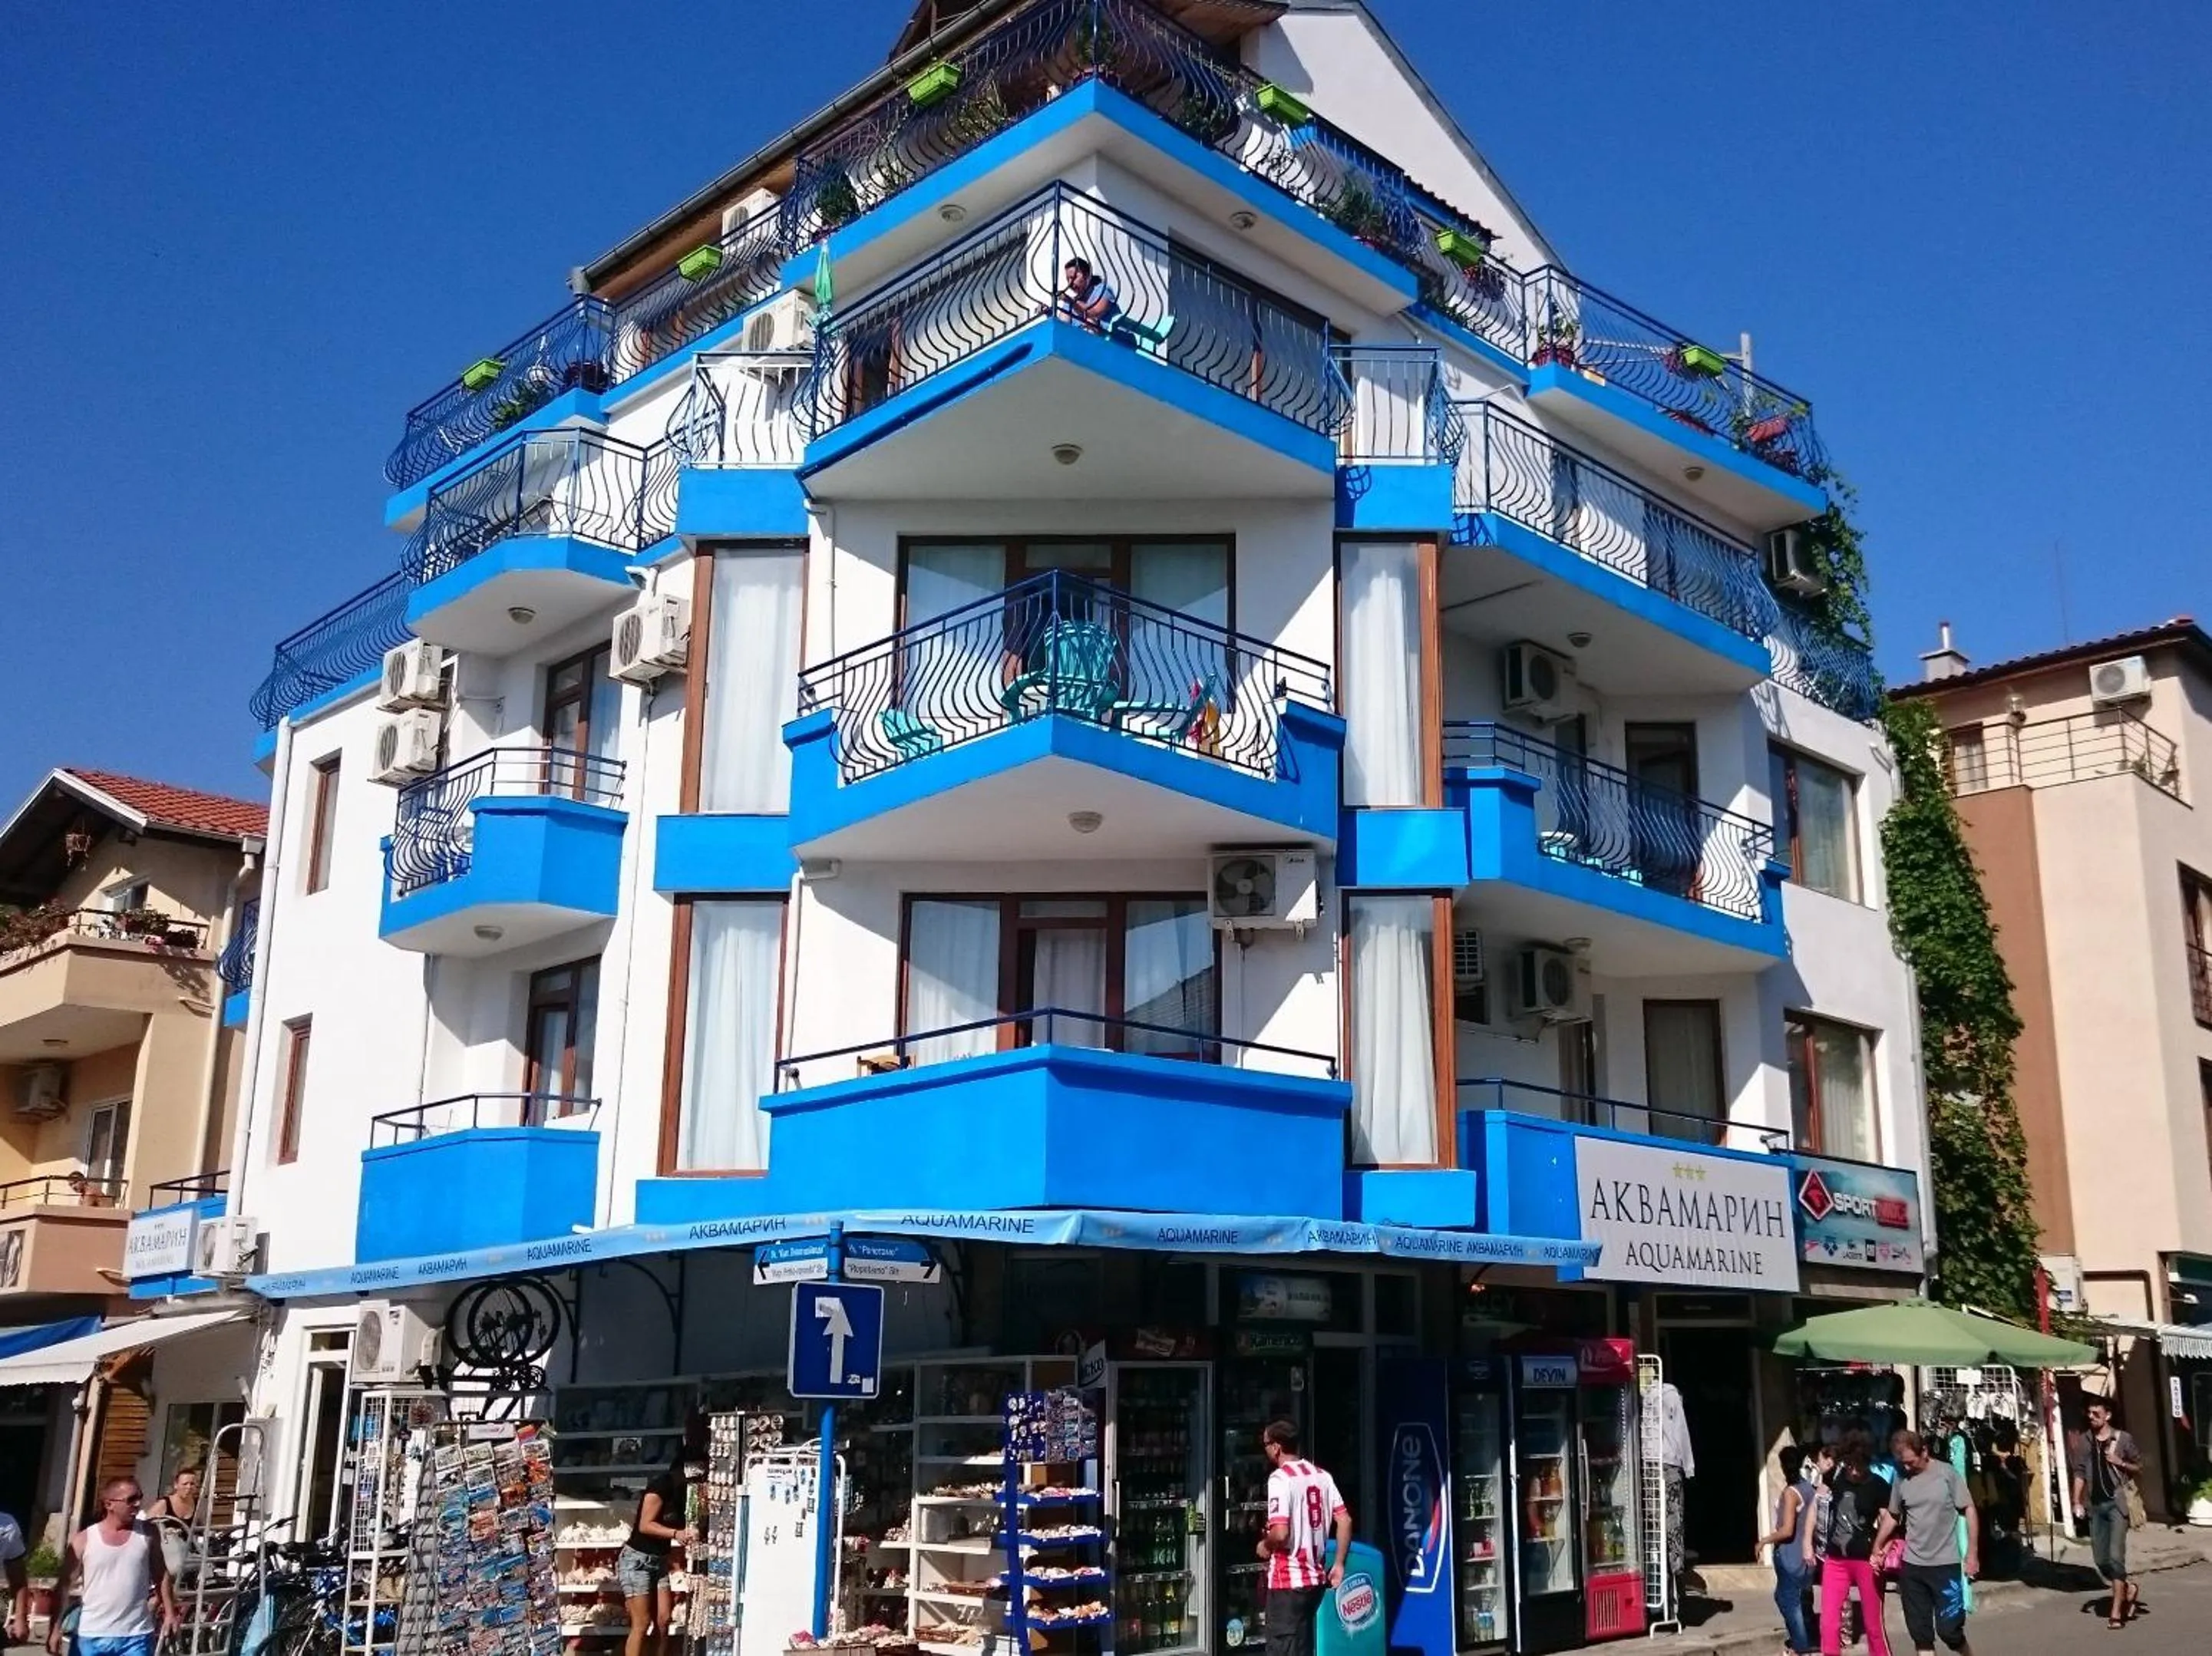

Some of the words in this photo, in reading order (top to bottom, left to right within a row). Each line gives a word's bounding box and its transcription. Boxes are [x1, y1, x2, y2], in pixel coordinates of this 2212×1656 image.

[1590, 1178, 1785, 1238] АКВАМАРИН
[1833, 1192, 1877, 1217] SPORT
[689, 1217, 787, 1240] АКВАМАРИН
[900, 1214, 1035, 1234] AQUAMARINE
[129, 1227, 187, 1255] АКВАМАРИН
[1157, 1227, 1238, 1245] AQUAMARINE
[1395, 1236, 1462, 1253] AQUAMARINE
[527, 1238, 593, 1261] AQUAMARINE
[1467, 1241, 1524, 1257] АКВАМАРИН
[1626, 1241, 1763, 1275] AQUAMARINE
[350, 1266, 399, 1285] AQUAMARINE
[418, 1258, 467, 1275] АКВАМАРИН
[1533, 1367, 1567, 1382] DEVIN
[1306, 1485, 1322, 1529] 8
[1402, 1434, 1425, 1577] DANONE
